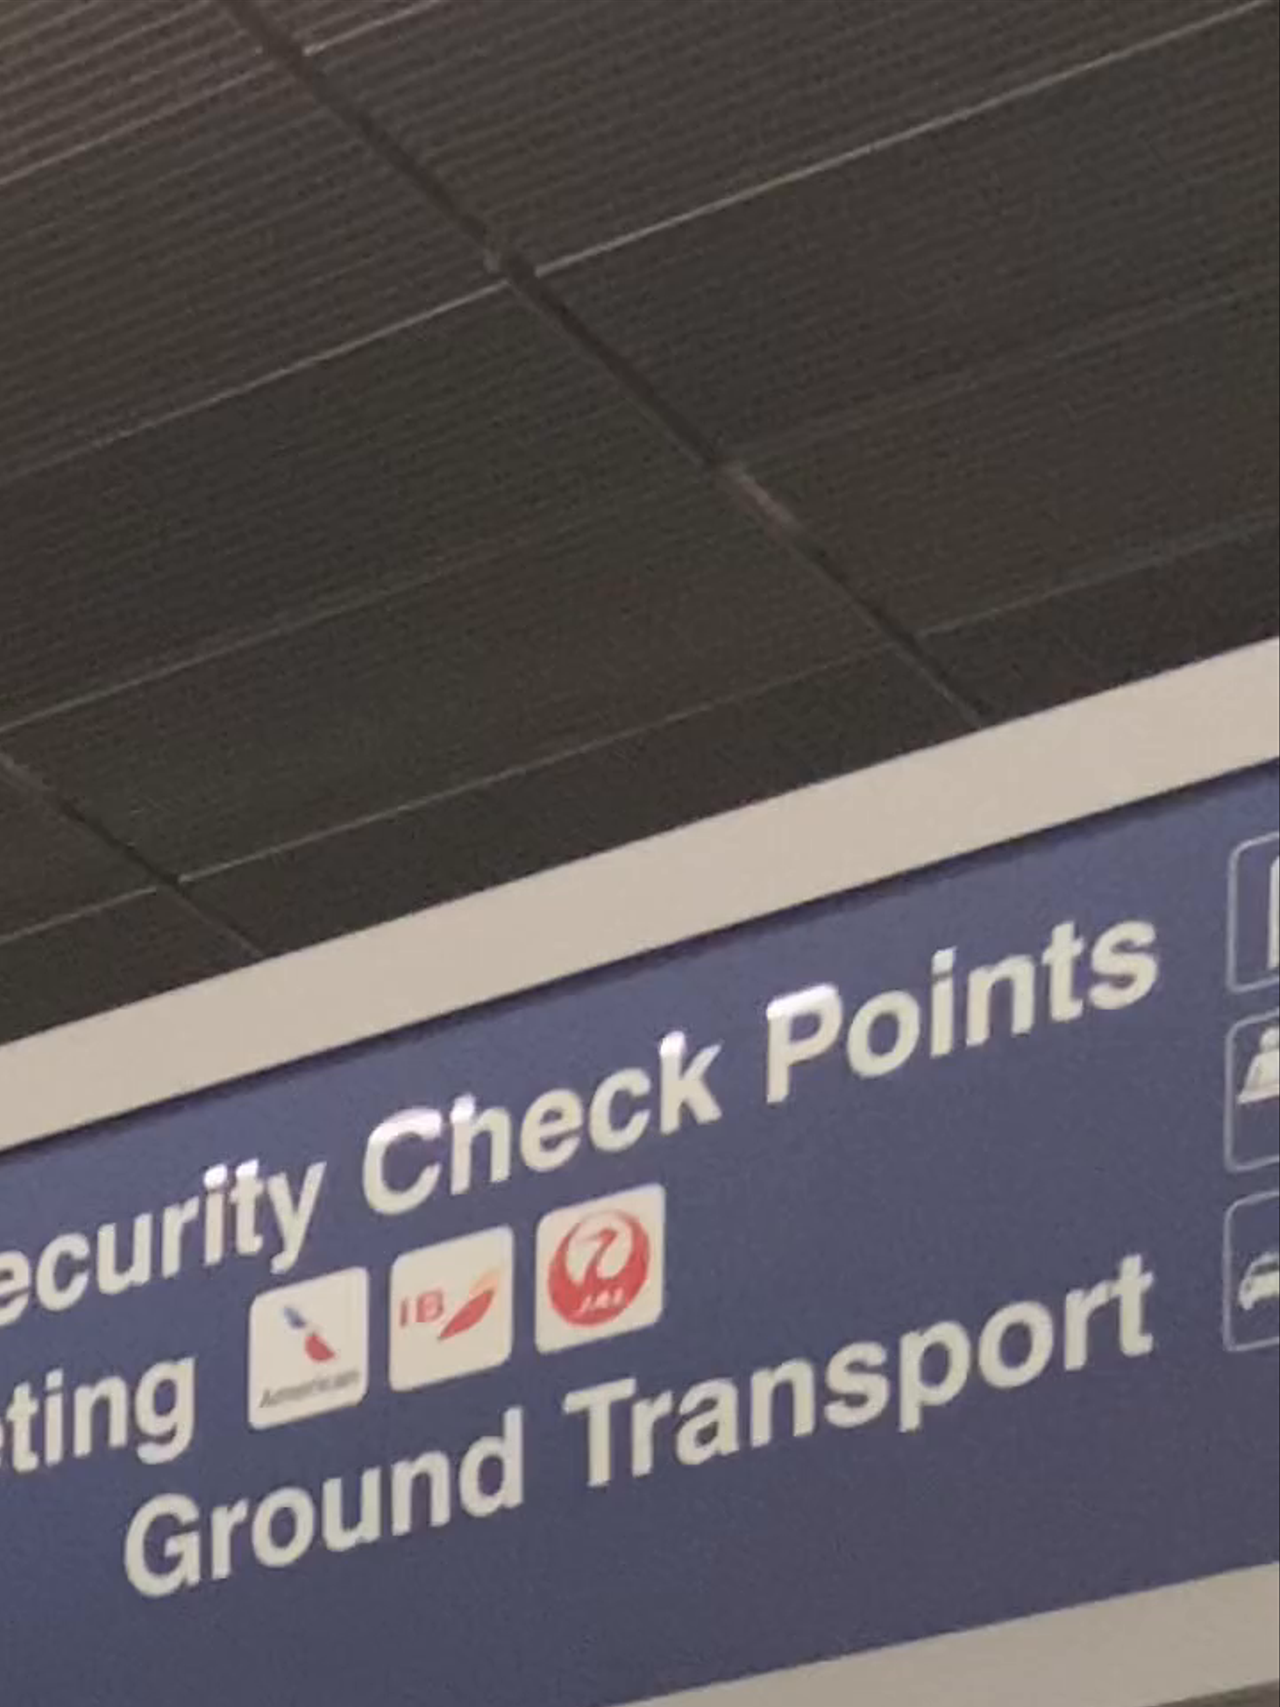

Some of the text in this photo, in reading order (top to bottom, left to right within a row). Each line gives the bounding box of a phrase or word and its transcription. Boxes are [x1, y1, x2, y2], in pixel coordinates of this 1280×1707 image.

[364, 1031, 723, 1215] Check
[767, 919, 1158, 1107] Points
[127, 1255, 1154, 1597] Ground Transport
